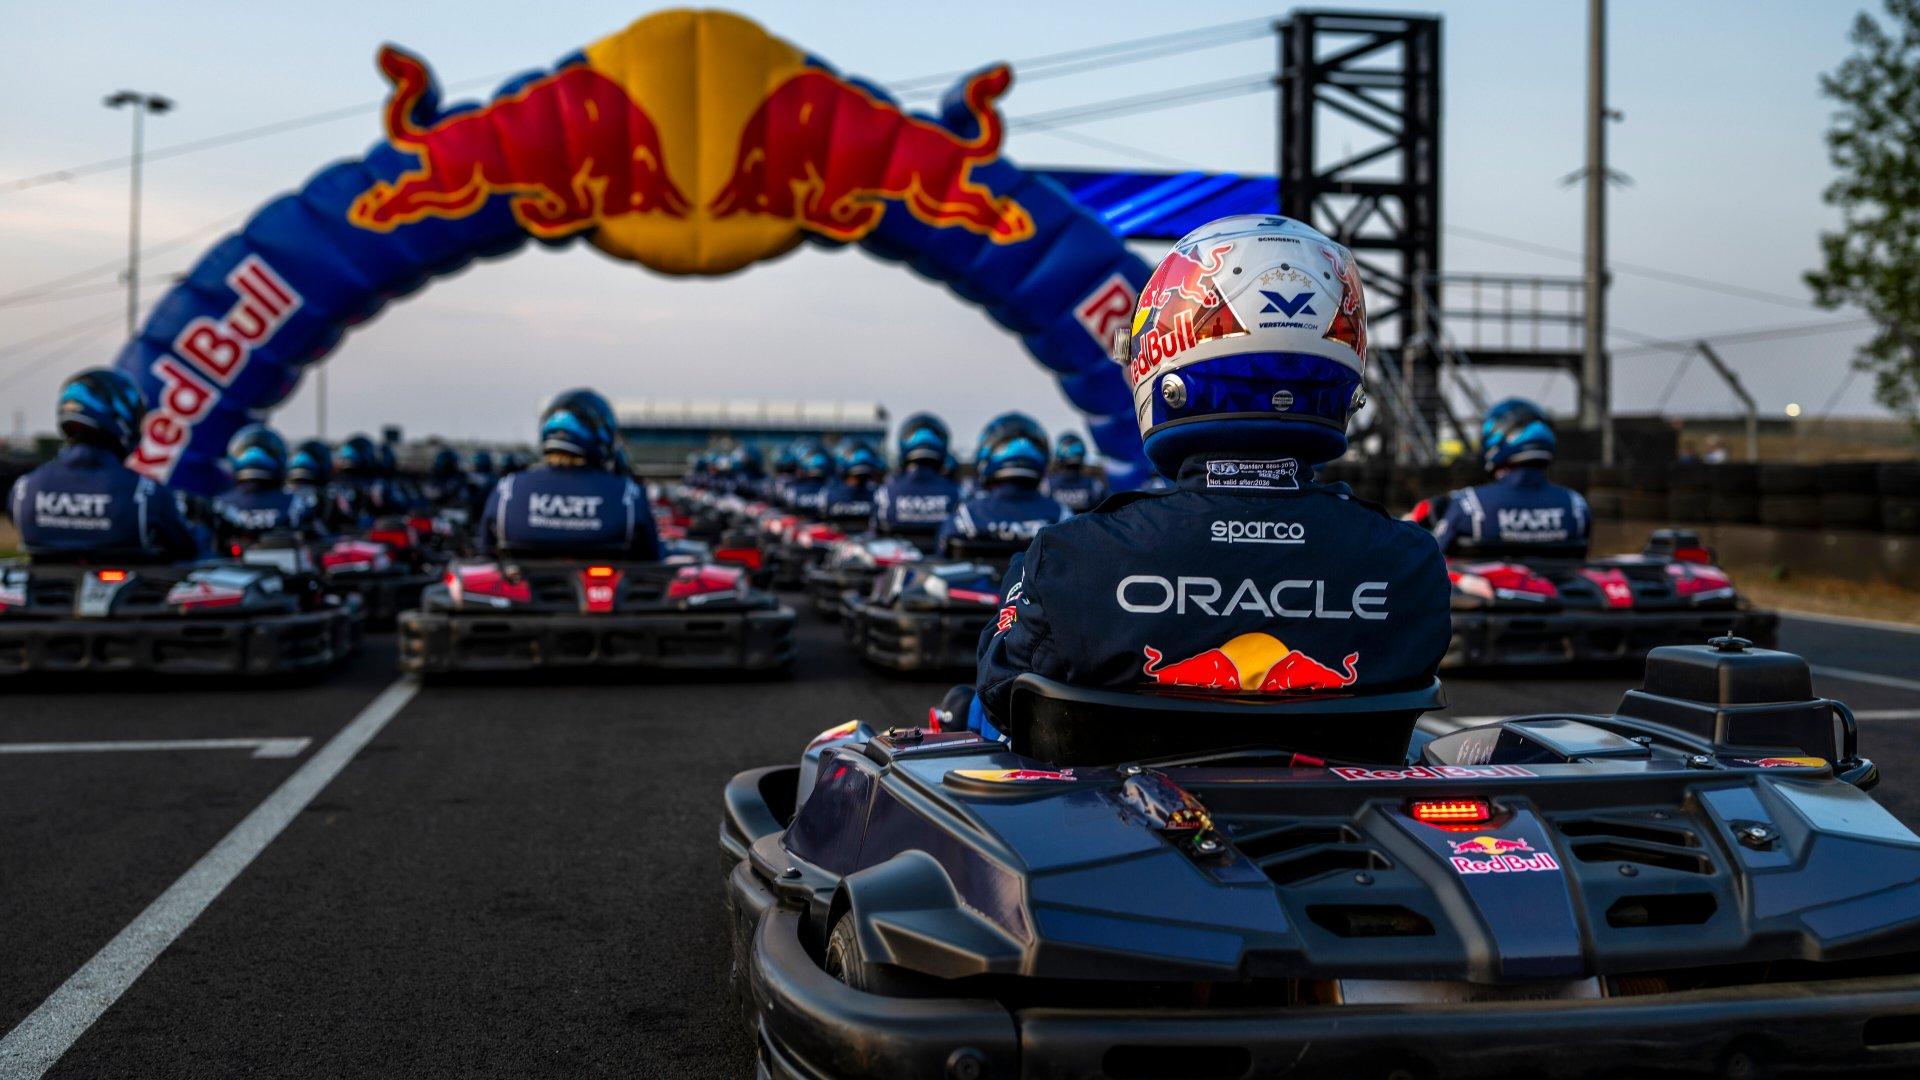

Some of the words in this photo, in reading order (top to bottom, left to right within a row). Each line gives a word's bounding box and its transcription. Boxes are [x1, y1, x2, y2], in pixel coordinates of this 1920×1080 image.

[1259, 321, 1318, 331] VERSTAPPEN.COM
[35, 491, 112, 516] KART
[529, 493, 603, 516] KART
[1498, 508, 1564, 530] KART
[1211, 520, 1305, 543] sparco
[1116, 575, 1389, 620] ORACLE
